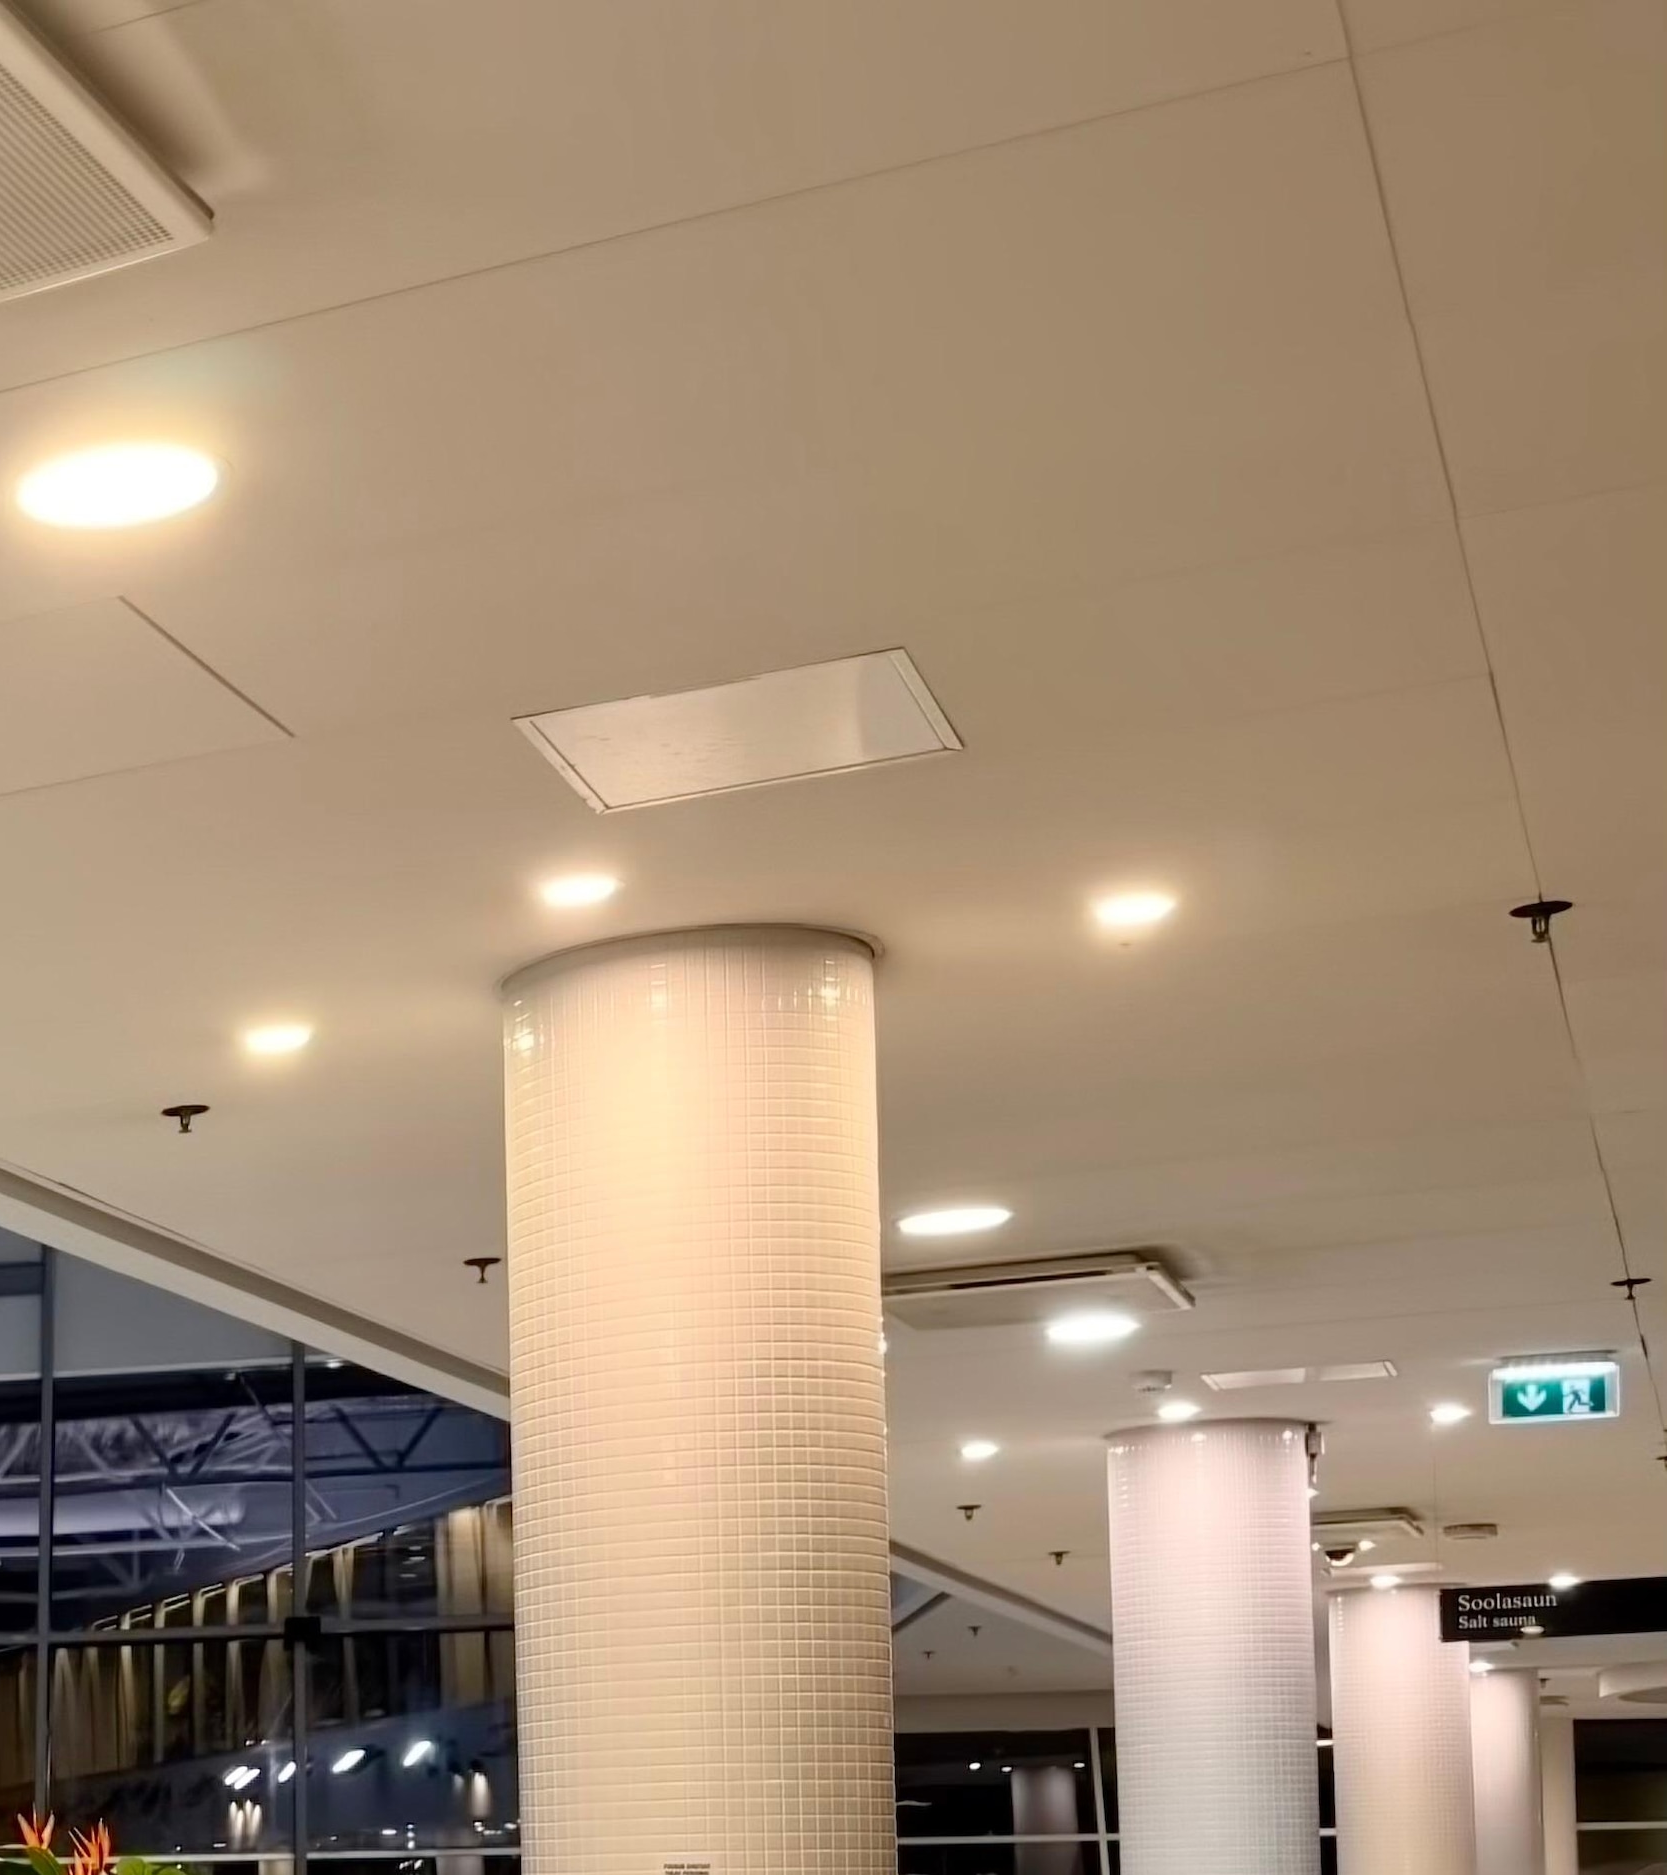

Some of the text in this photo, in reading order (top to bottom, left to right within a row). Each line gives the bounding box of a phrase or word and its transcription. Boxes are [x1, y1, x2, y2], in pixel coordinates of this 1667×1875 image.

[1458, 1592, 1558, 1611] Soolasaun
[1458, 1614, 1536, 1629] Salt sauna
